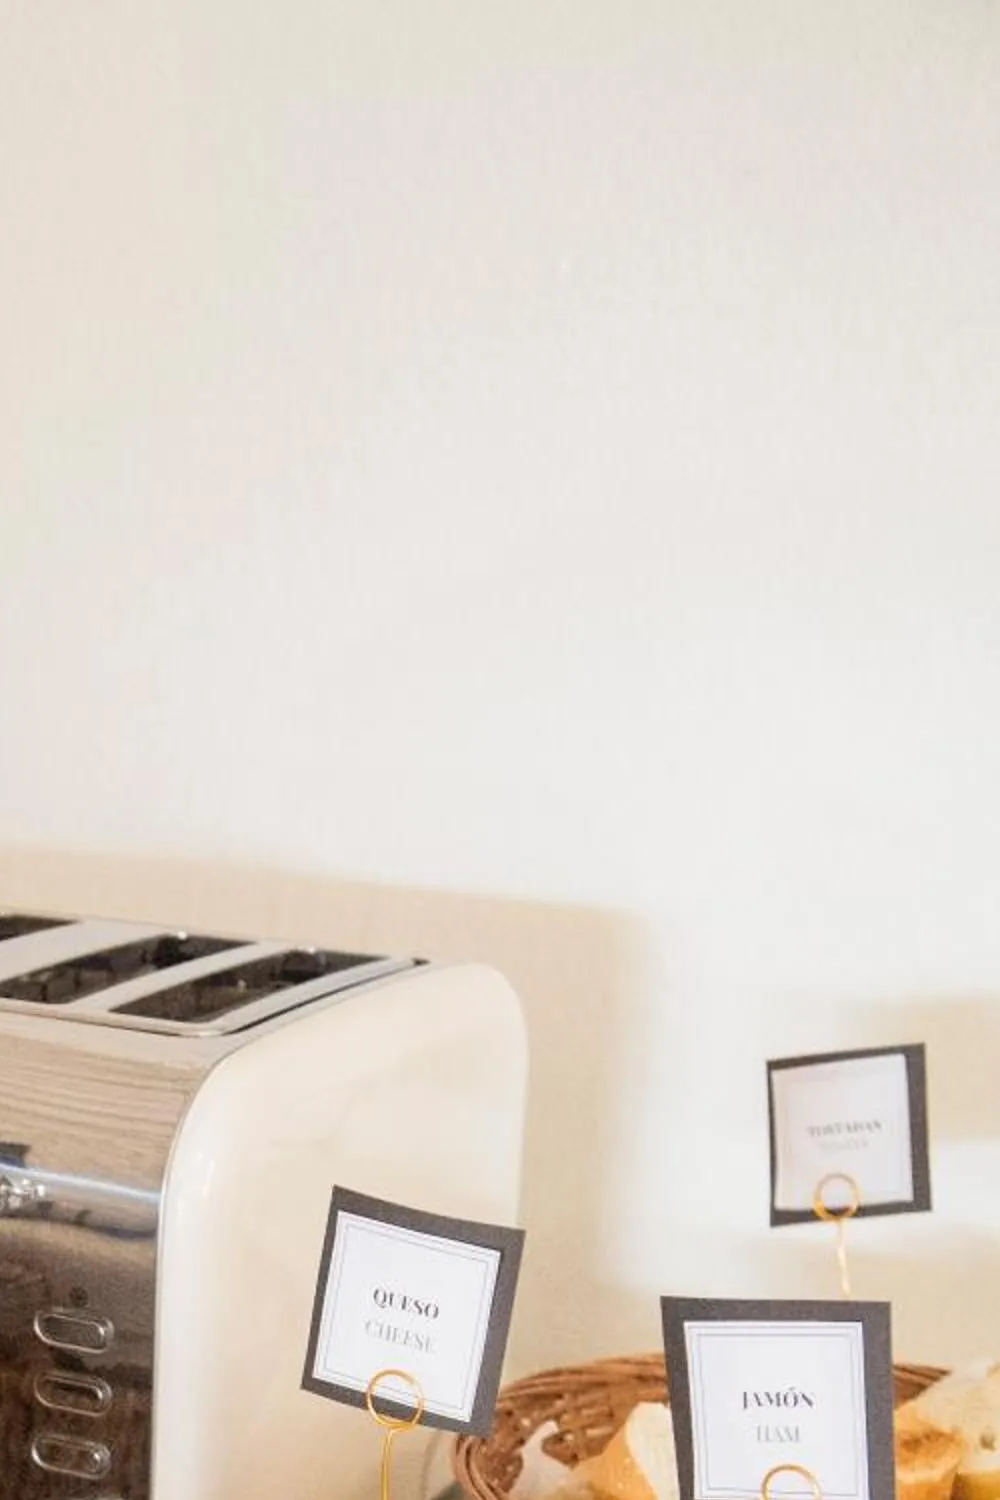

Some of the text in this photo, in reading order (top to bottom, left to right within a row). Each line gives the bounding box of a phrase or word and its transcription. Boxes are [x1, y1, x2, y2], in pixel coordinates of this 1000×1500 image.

[373, 1288, 440, 1319] QUESO
[364, 1320, 437, 1354] CHEESE
[742, 1386, 815, 1410] JAMÓN
[756, 1424, 800, 1443] HAM
